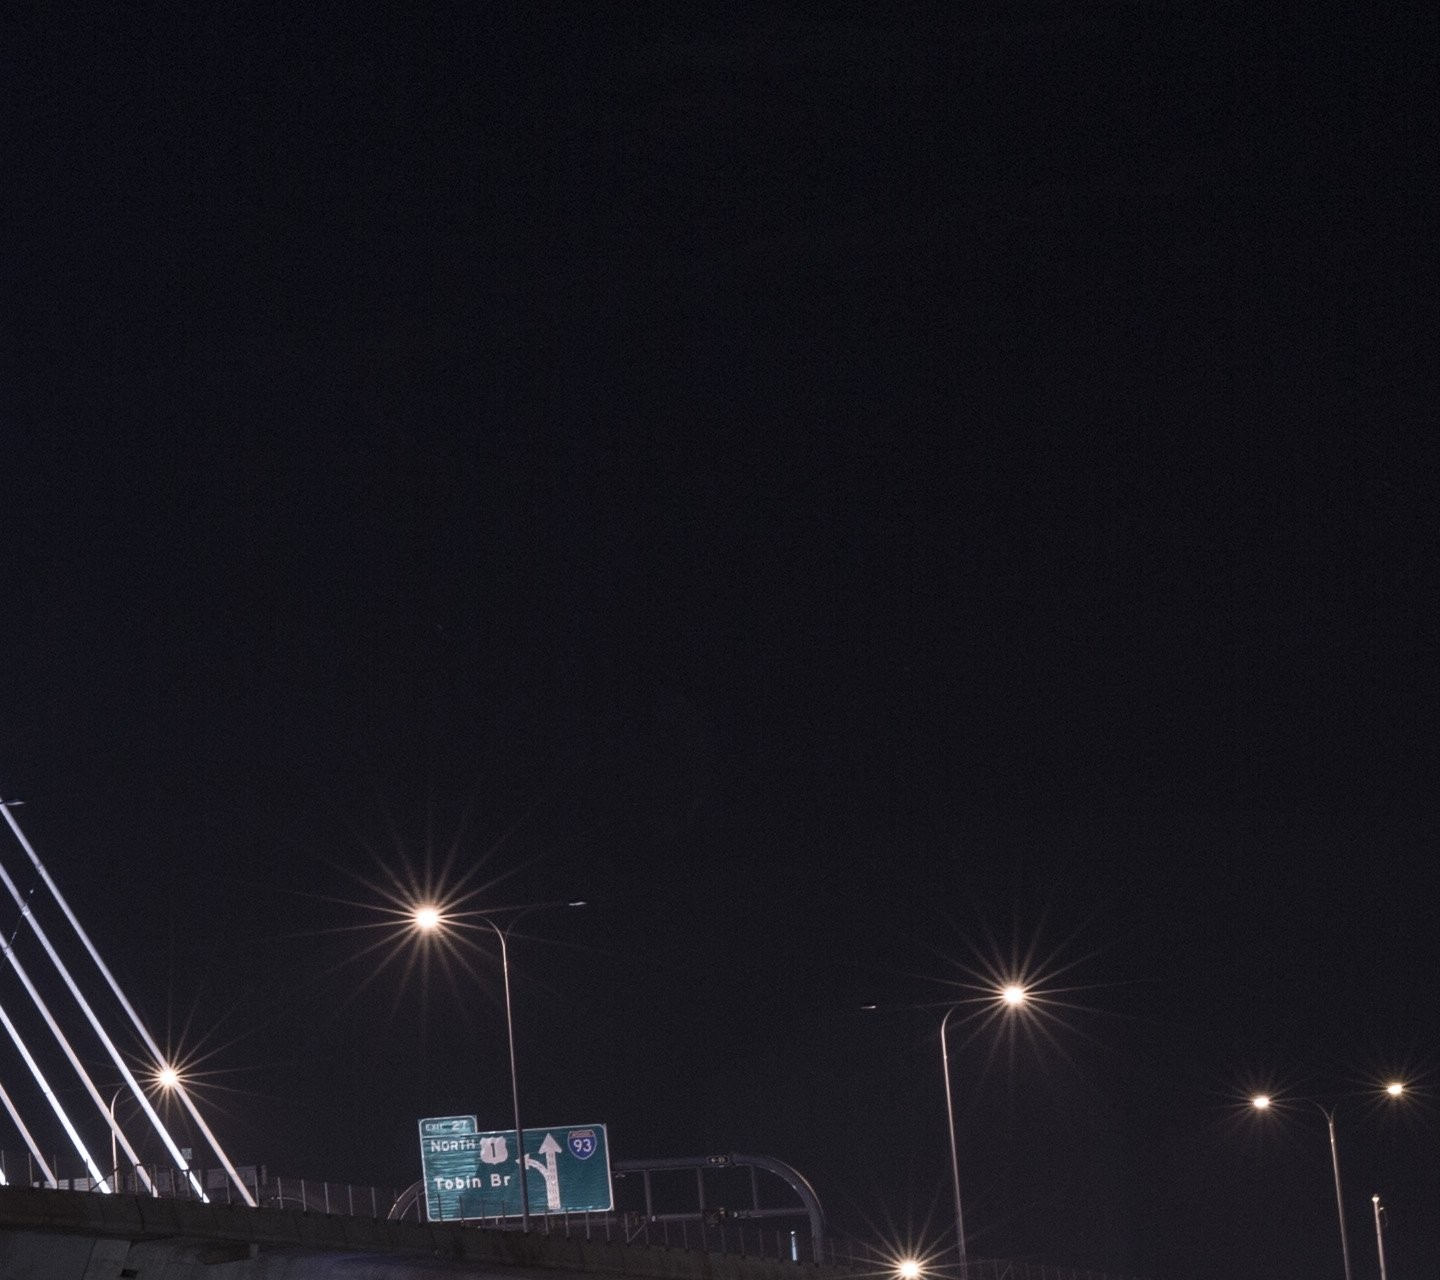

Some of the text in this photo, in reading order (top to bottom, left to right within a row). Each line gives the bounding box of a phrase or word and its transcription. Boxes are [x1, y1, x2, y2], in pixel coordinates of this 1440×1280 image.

[425, 1120, 468, 1131] EXIT 27
[430, 1139, 476, 1152] NORTH
[490, 1142, 496, 1158] 1
[573, 1138, 593, 1153] 93
[434, 1173, 511, 1190] Tobin Br
